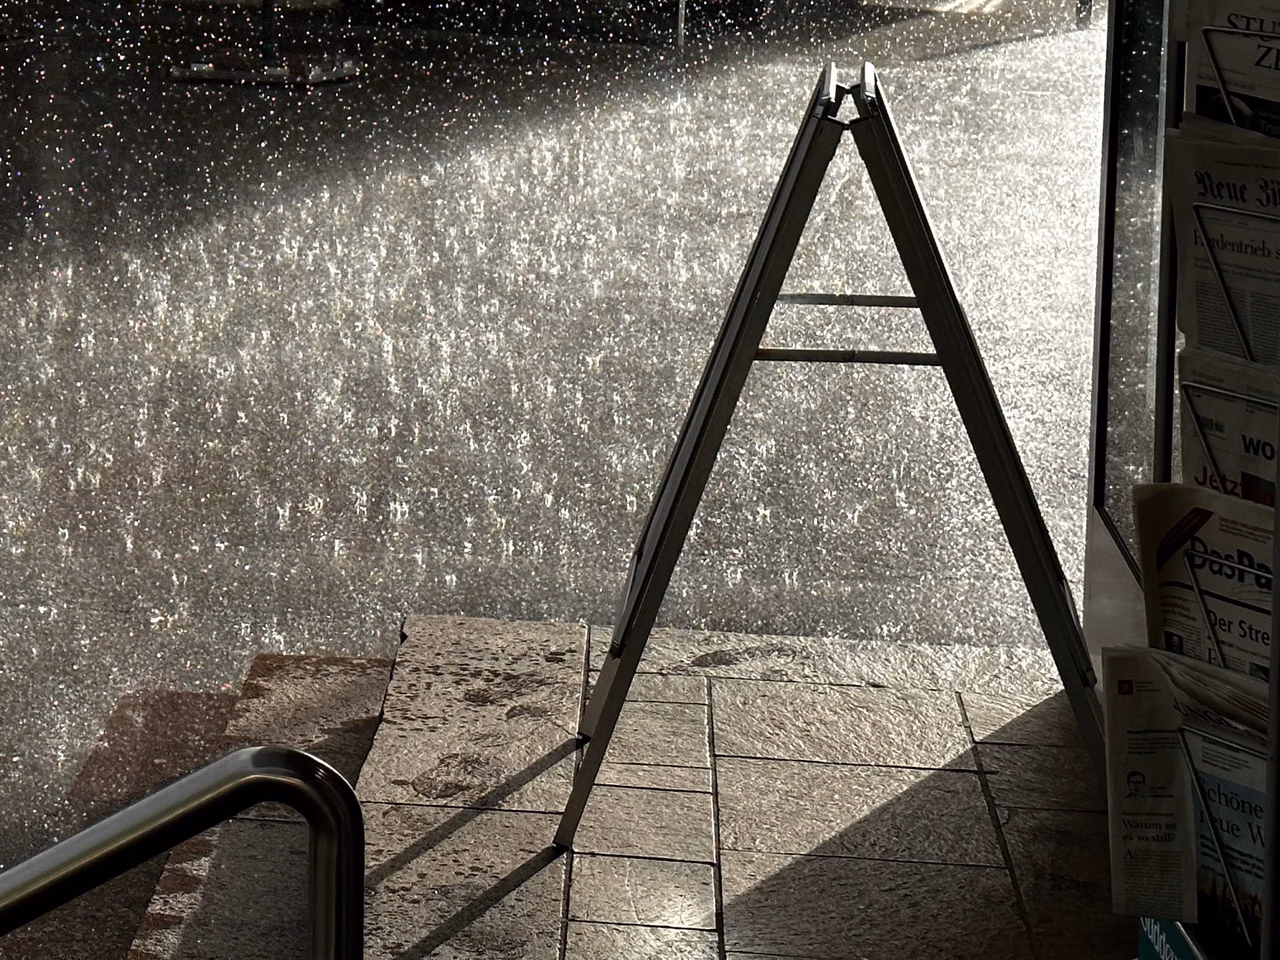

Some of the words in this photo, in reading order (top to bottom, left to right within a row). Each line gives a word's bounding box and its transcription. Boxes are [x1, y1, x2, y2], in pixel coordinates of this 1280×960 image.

[1226, 12, 1280, 42] STU
[1194, 170, 1248, 203] Neue
[1193, 228, 1271, 258] Hrdentrieb
[1194, 466, 1243, 498] Jetz
[1238, 619, 1271, 646] Stre
[1122, 818, 1161, 829] Warum
[1165, 821, 1177, 829] ist
[1199, 809, 1240, 839] eue
